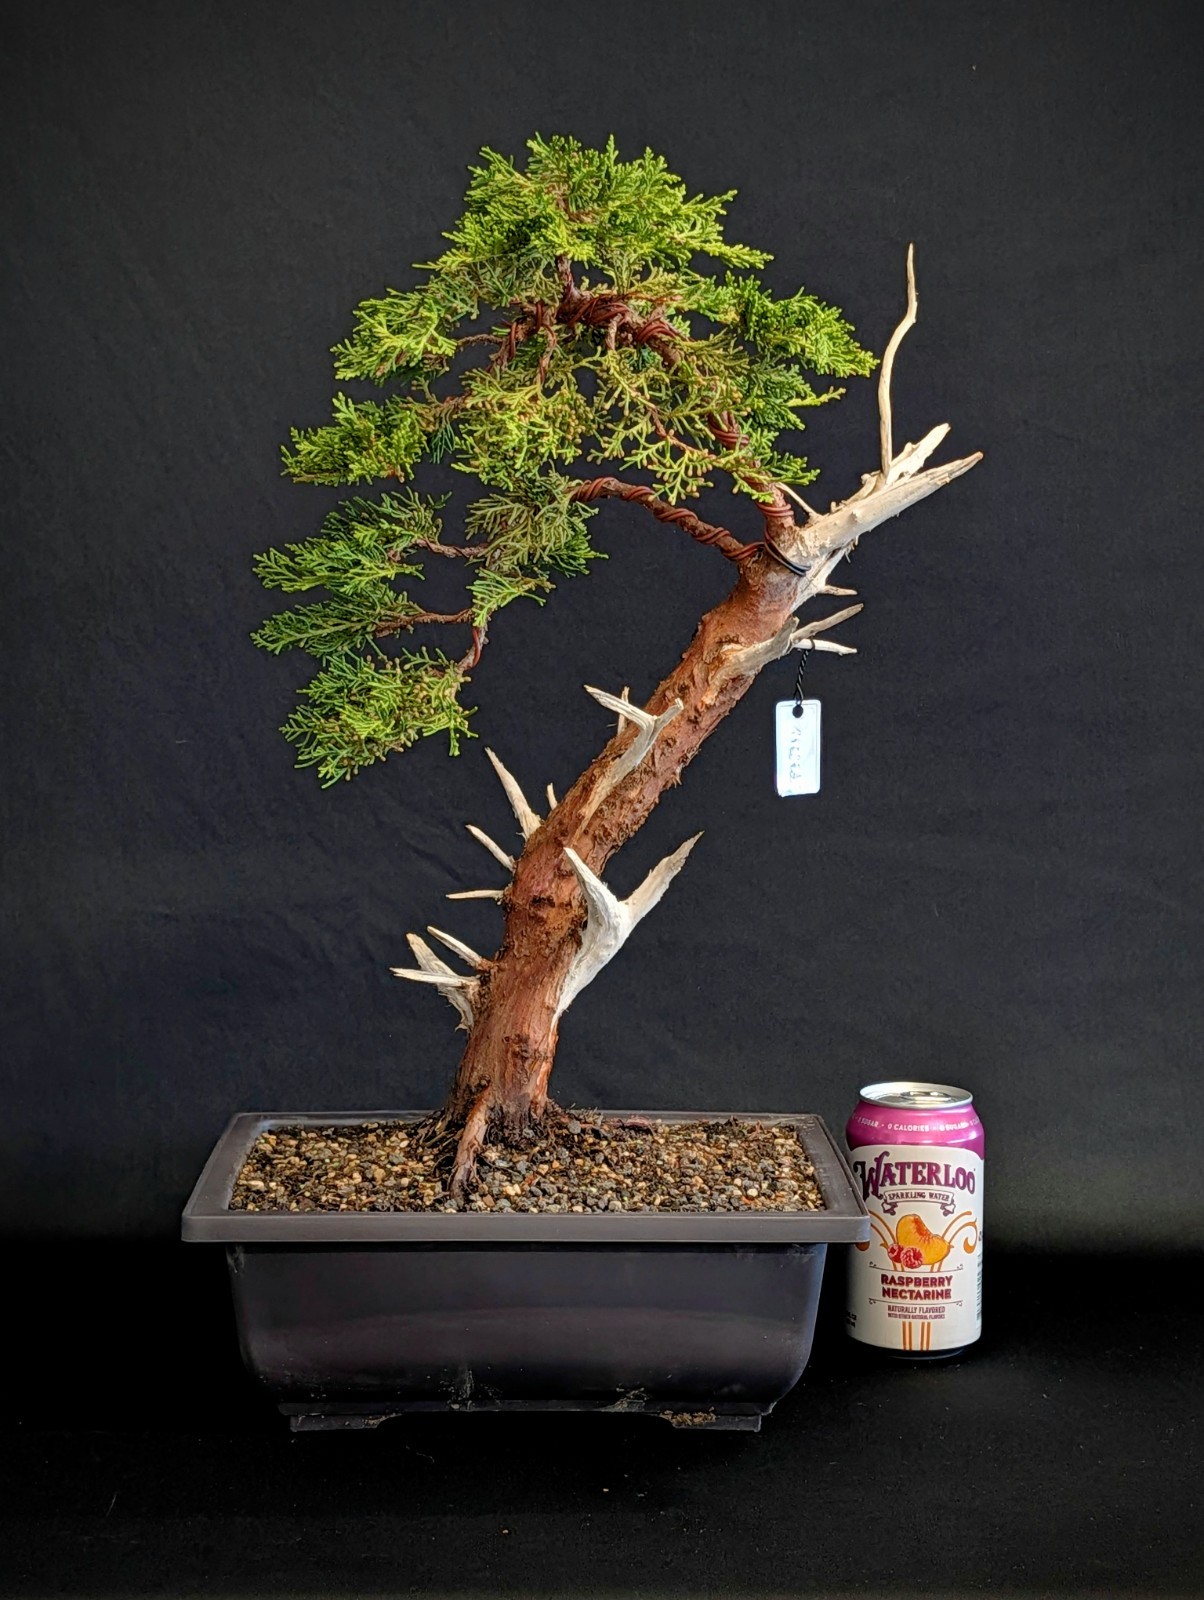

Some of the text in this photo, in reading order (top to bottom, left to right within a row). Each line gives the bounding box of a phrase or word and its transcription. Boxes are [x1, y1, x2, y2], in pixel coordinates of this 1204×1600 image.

[861, 1117, 879, 1127] SUGAR
[853, 1151, 976, 1201] WATERLOO
[888, 1192, 950, 1201] SPARKLING WATER
[881, 1274, 953, 1287] RASPBERRY
[882, 1287, 952, 1300] NECTARINE
[888, 1305, 945, 1314] NATURALLY FLAVORED
